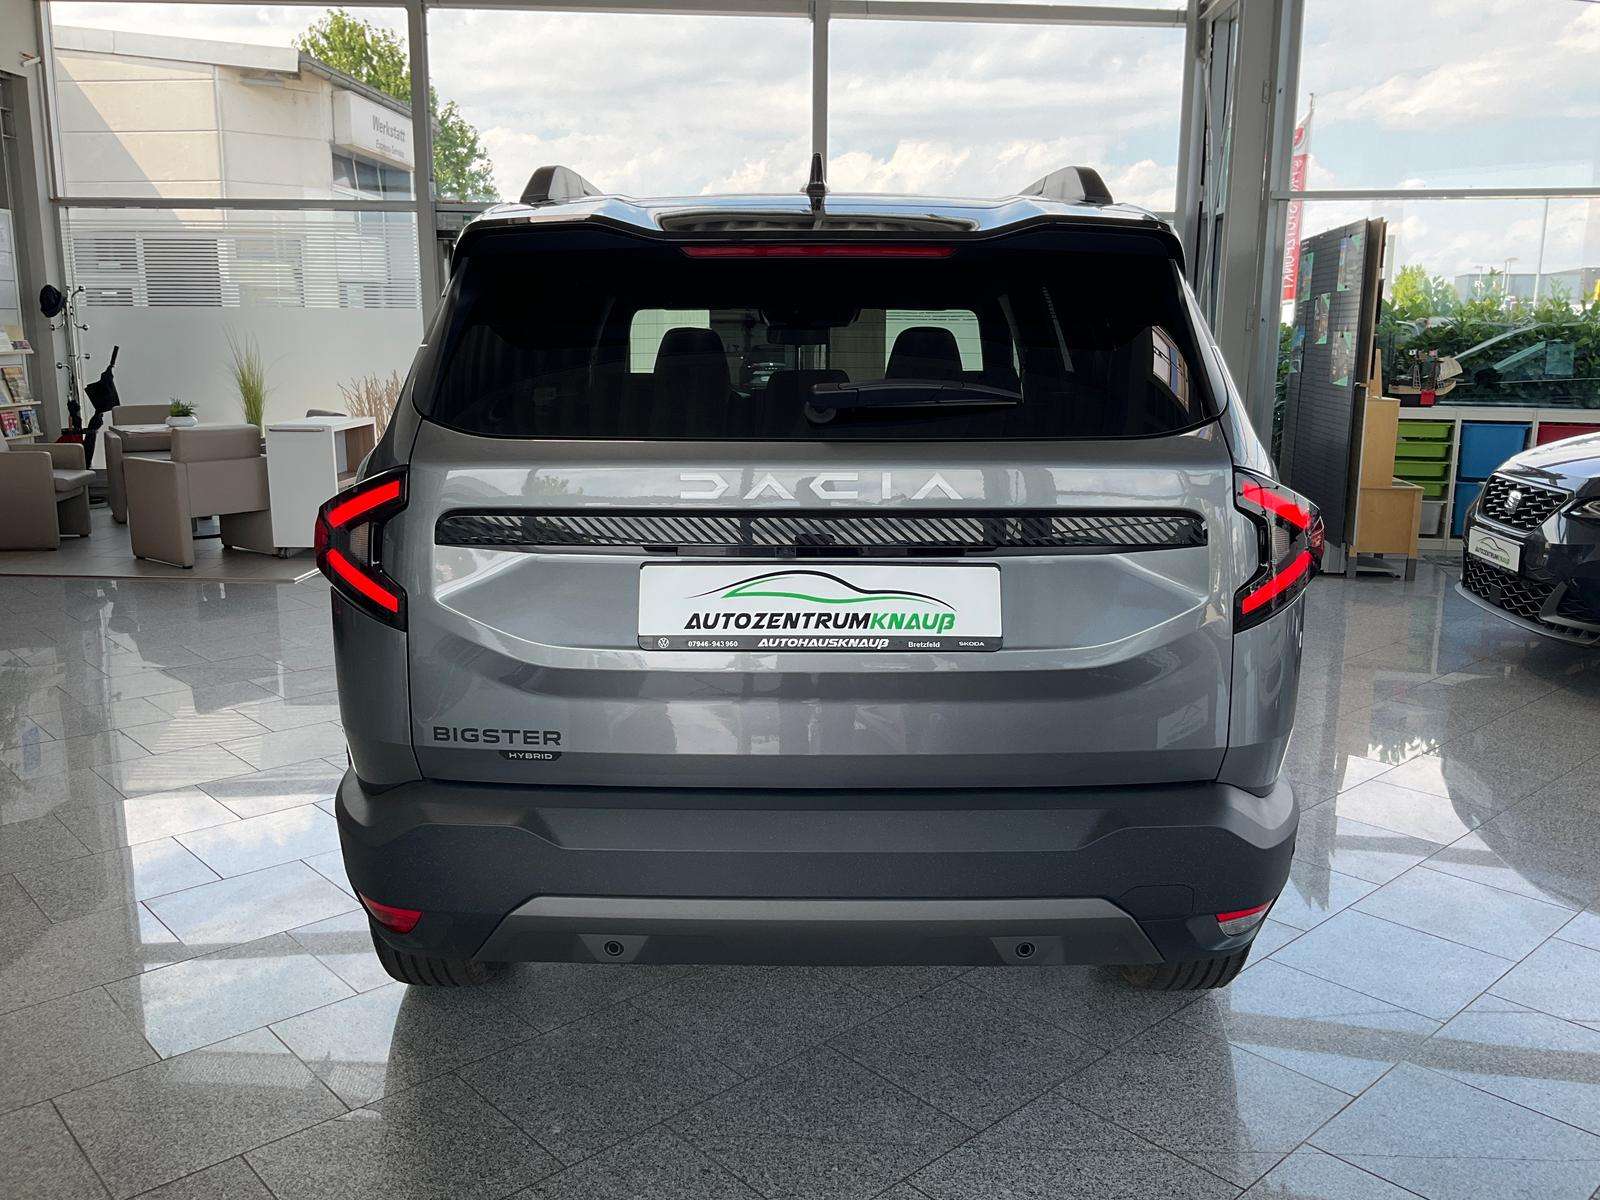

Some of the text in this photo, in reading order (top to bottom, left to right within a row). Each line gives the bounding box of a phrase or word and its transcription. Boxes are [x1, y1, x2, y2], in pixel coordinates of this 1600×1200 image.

[373, 114, 405, 142] Werkstatt
[680, 472, 964, 500] DACIA
[908, 640, 941, 649] Bretzfeld
[433, 726, 562, 746] BIGSTER
[508, 752, 553, 760] HYBRID
